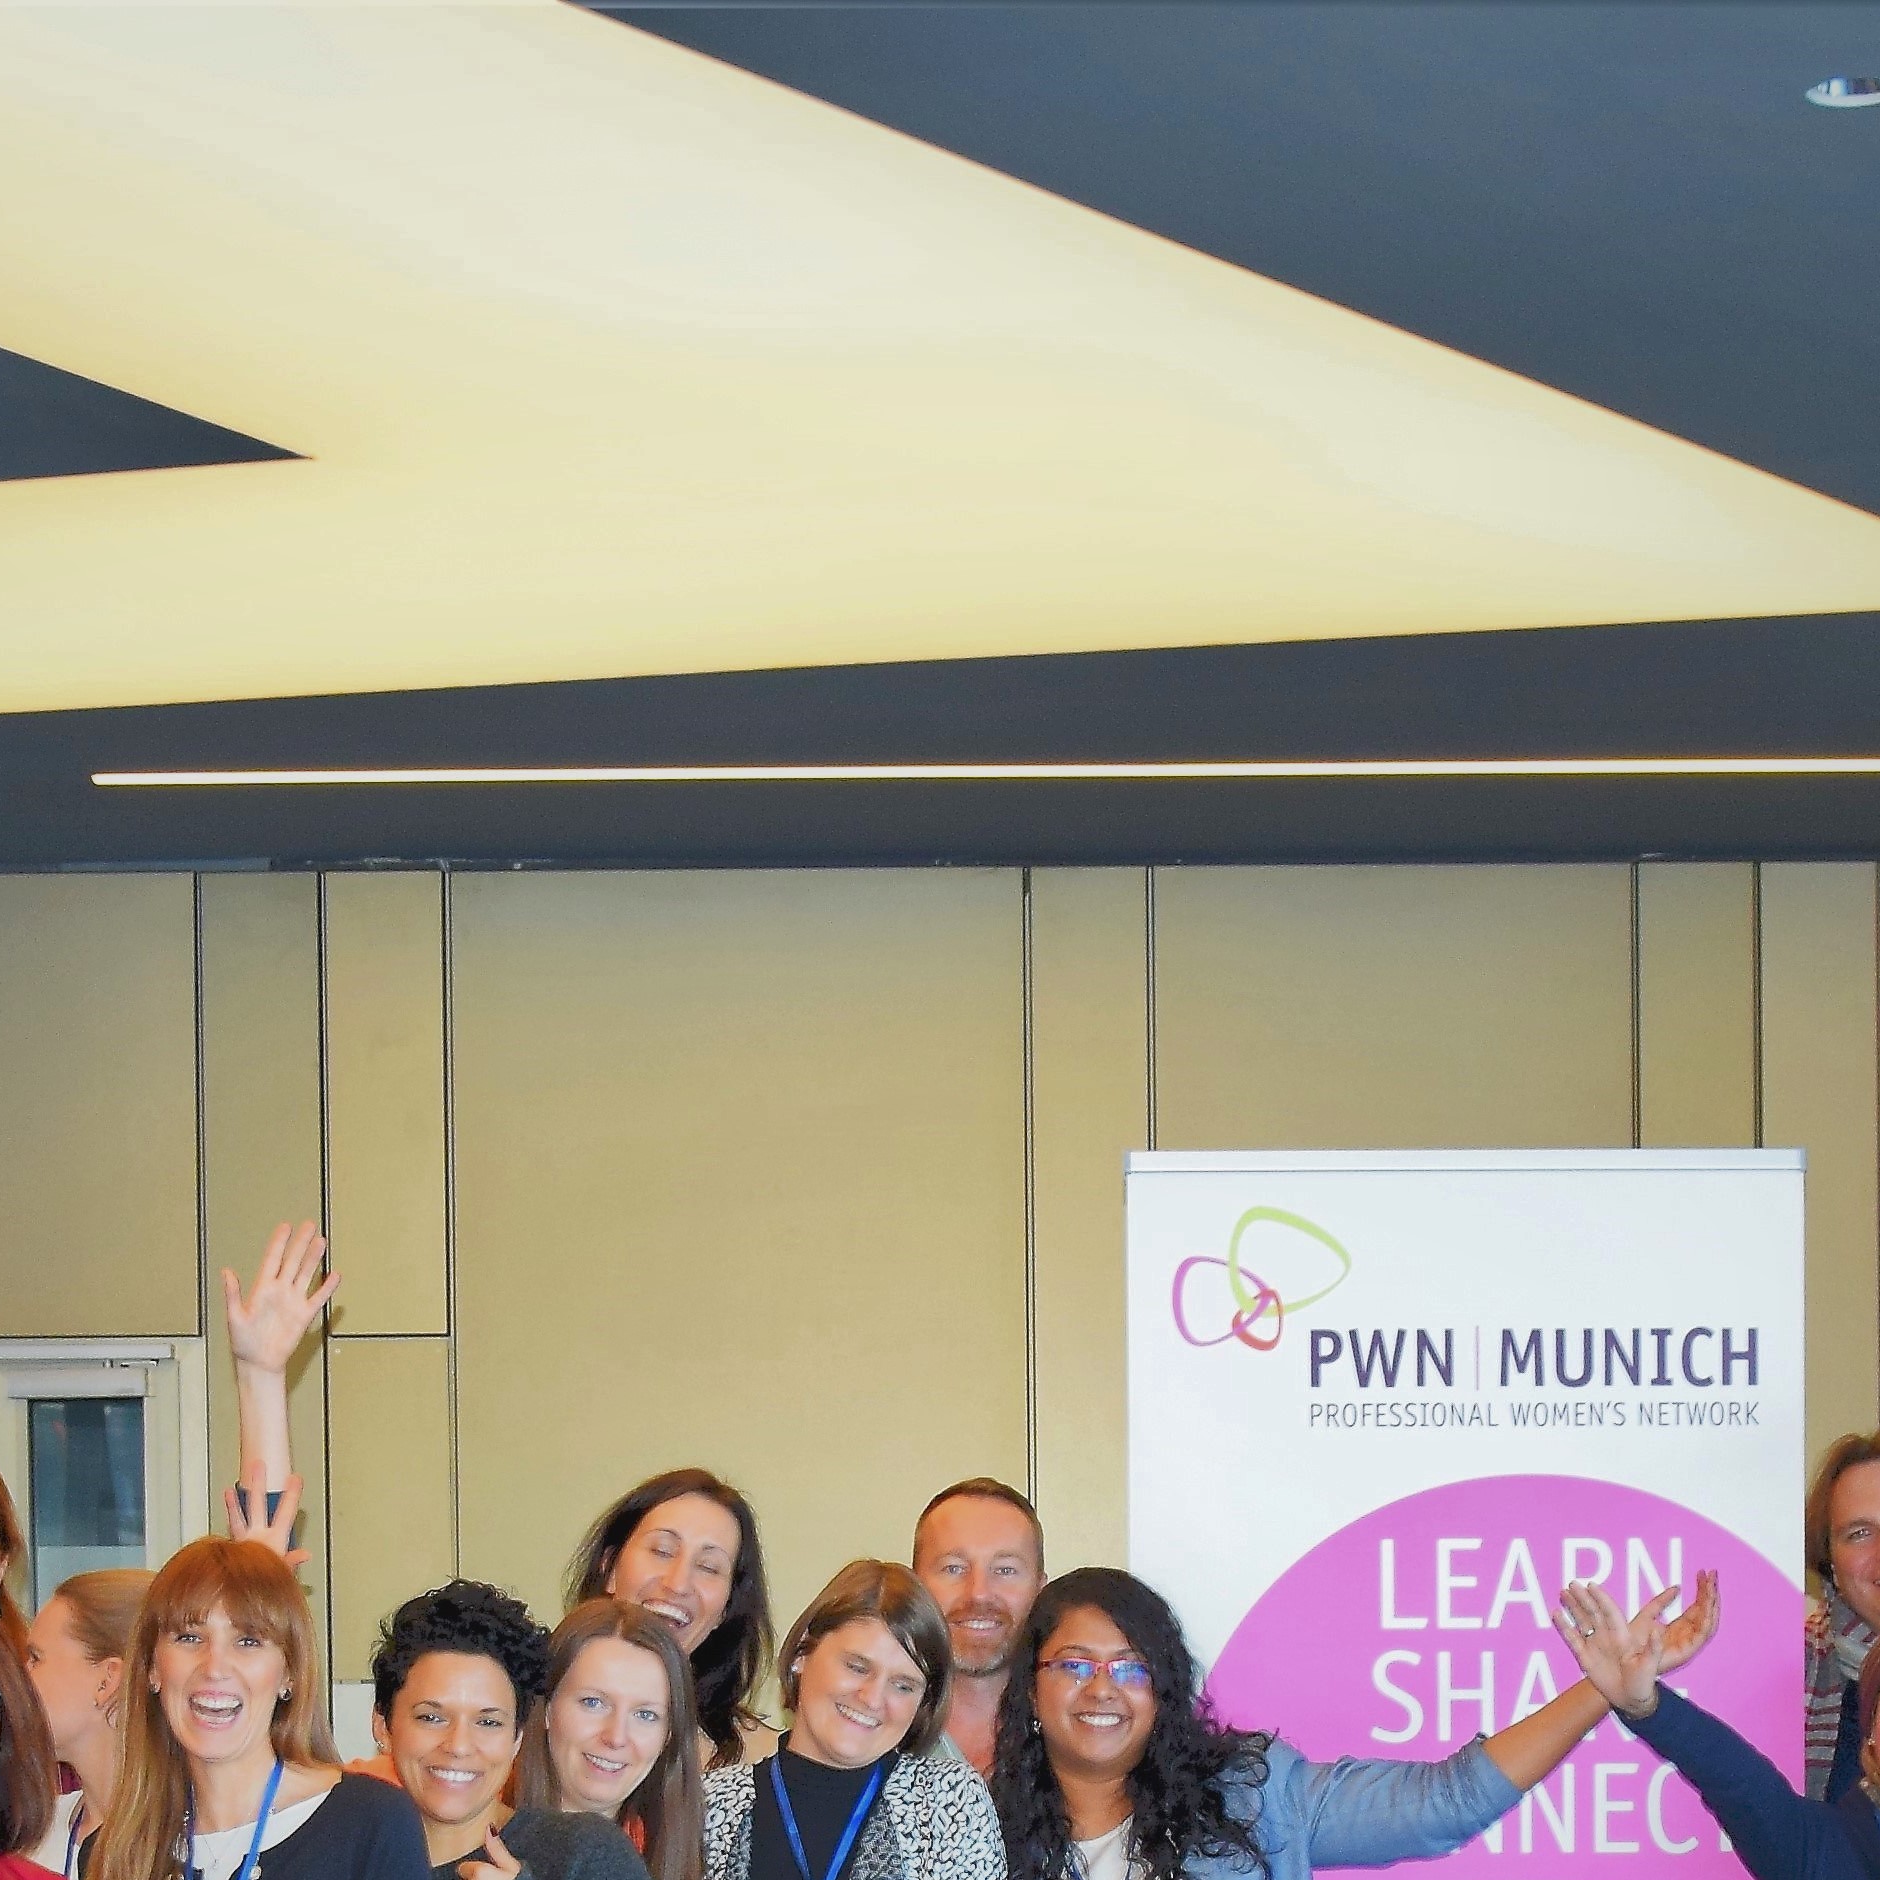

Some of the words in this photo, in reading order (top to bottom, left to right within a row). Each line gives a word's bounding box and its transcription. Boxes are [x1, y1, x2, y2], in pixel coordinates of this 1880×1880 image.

[1310, 1327, 1455, 1388] PWN
[1500, 1327, 1759, 1388] MUNICH
[1310, 1402, 1499, 1428] PROFESSIONAL
[1639, 1401, 1760, 1426] NETWORK
